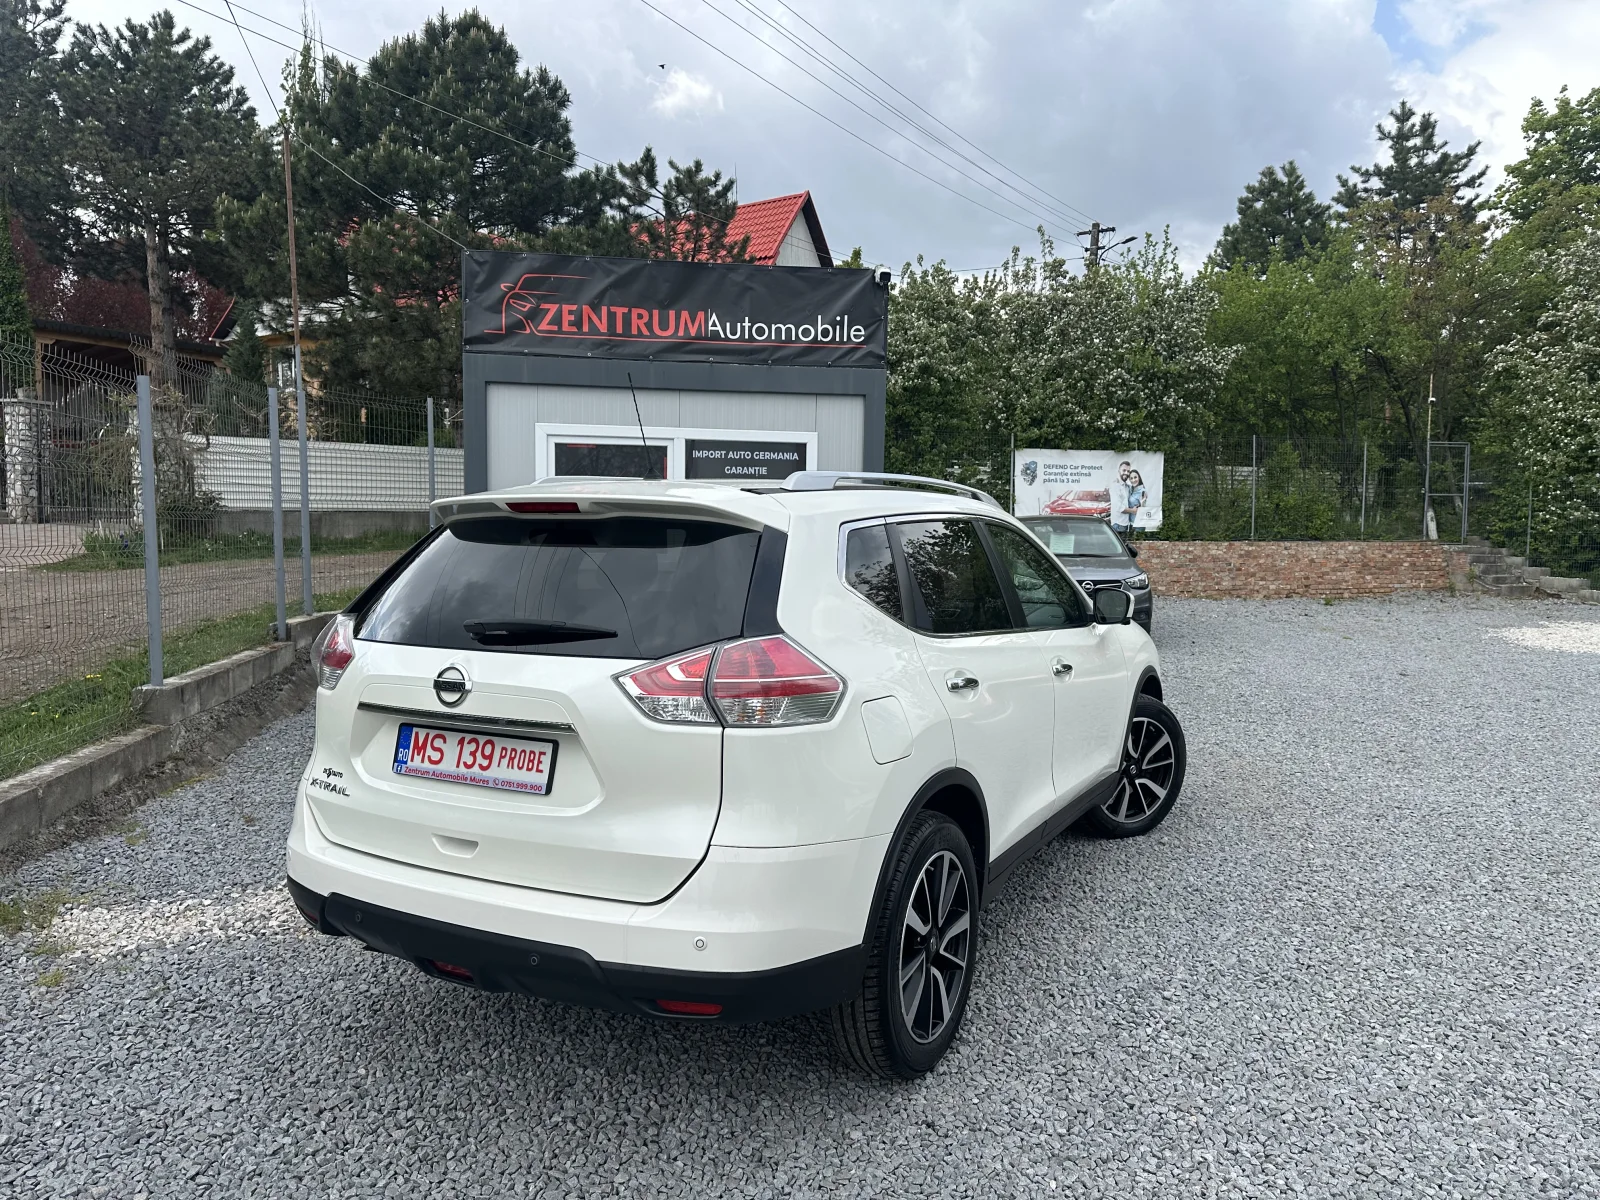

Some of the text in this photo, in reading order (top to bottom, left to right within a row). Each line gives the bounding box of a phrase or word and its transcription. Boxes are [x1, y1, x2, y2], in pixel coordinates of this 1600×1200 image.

[537, 303, 866, 342] ZENTRUM Automobile
[692, 450, 799, 460] IMPORT AUTO GERMANIA
[724, 466, 768, 476] GARANȚIE
[397, 748, 409, 762] RO
[410, 731, 547, 774] MS 139 PROBE
[310, 778, 350, 797] X-TRAIL
[404, 766, 431, 777] Zentrum
[431, 771, 468, 783] Automobile
[469, 776, 490, 786] Mures
[500, 780, 543, 792] 0751.999.900
